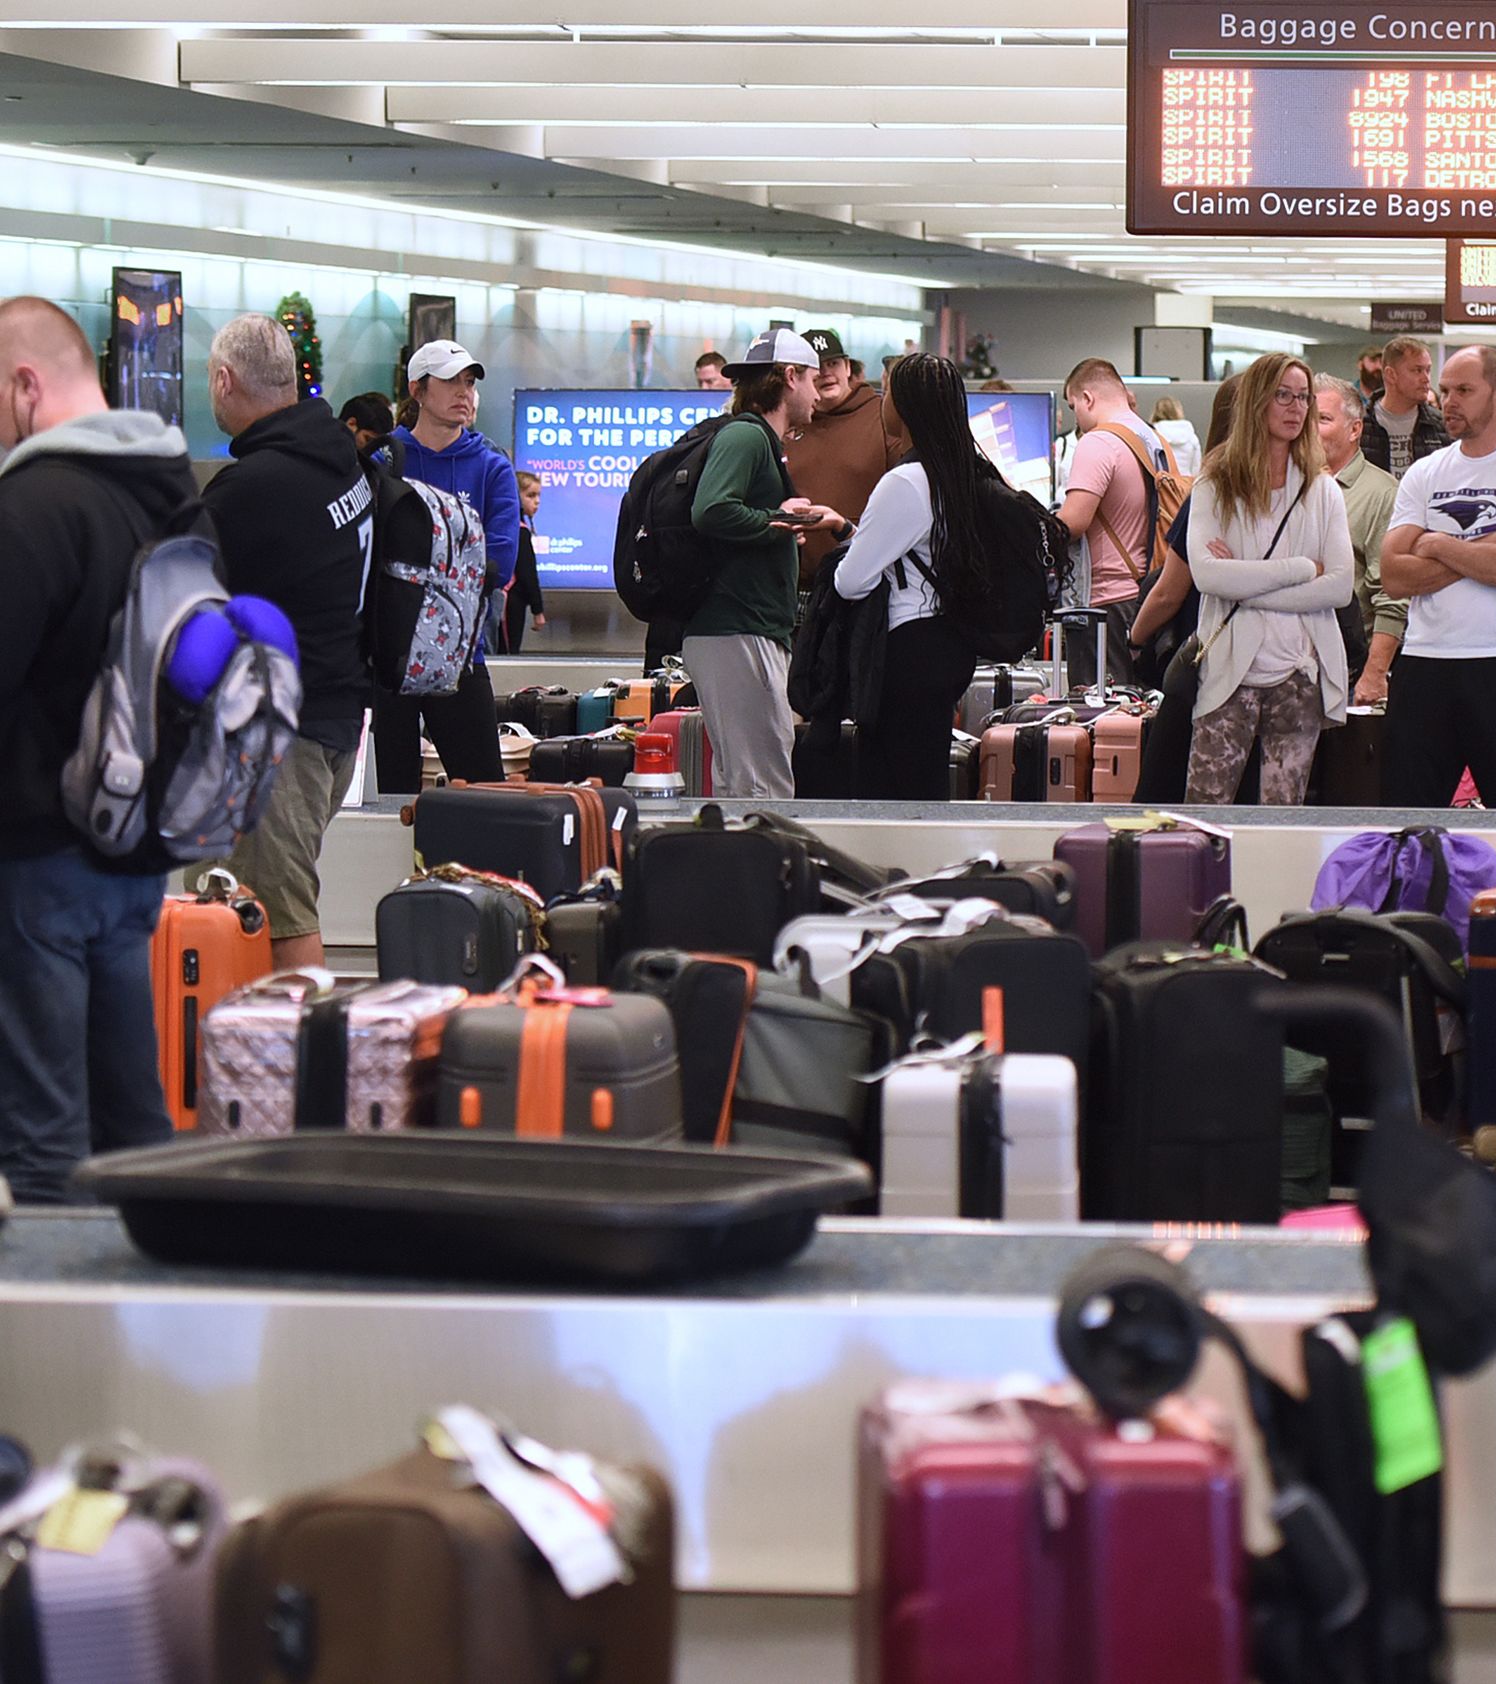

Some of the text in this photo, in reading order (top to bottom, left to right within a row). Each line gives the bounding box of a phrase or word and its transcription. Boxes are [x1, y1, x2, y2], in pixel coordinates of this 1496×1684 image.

[1220, 13, 1356, 45] Baggage
[1162, 87, 1254, 106] SPIRIT
[1353, 88, 1410, 108] 1947
[1162, 109, 1253, 127] SPIRIT
[1349, 111, 1410, 128] 8924
[1162, 127, 1253, 146] SPIRIT
[1353, 128, 1406, 148] 1691
[1162, 148, 1253, 165] SPIRIT
[1352, 150, 1410, 168] 1568
[1162, 166, 1253, 186] SPIRIT
[1367, 169, 1410, 188] 117
[1172, 191, 1250, 215] Claim
[1259, 192, 1377, 217] Oversize
[1387, 194, 1451, 222] Bags
[1388, 310, 1427, 321] UNITED
[526, 406, 566, 424] DR.
[572, 407, 674, 425] PHILLIPS
[526, 428, 573, 446] FOR
[578, 429, 624, 446] THE
[588, 455, 648, 472] COOL
[536, 472, 633, 488] EW TOURI
[355, 514, 373, 616] 7
